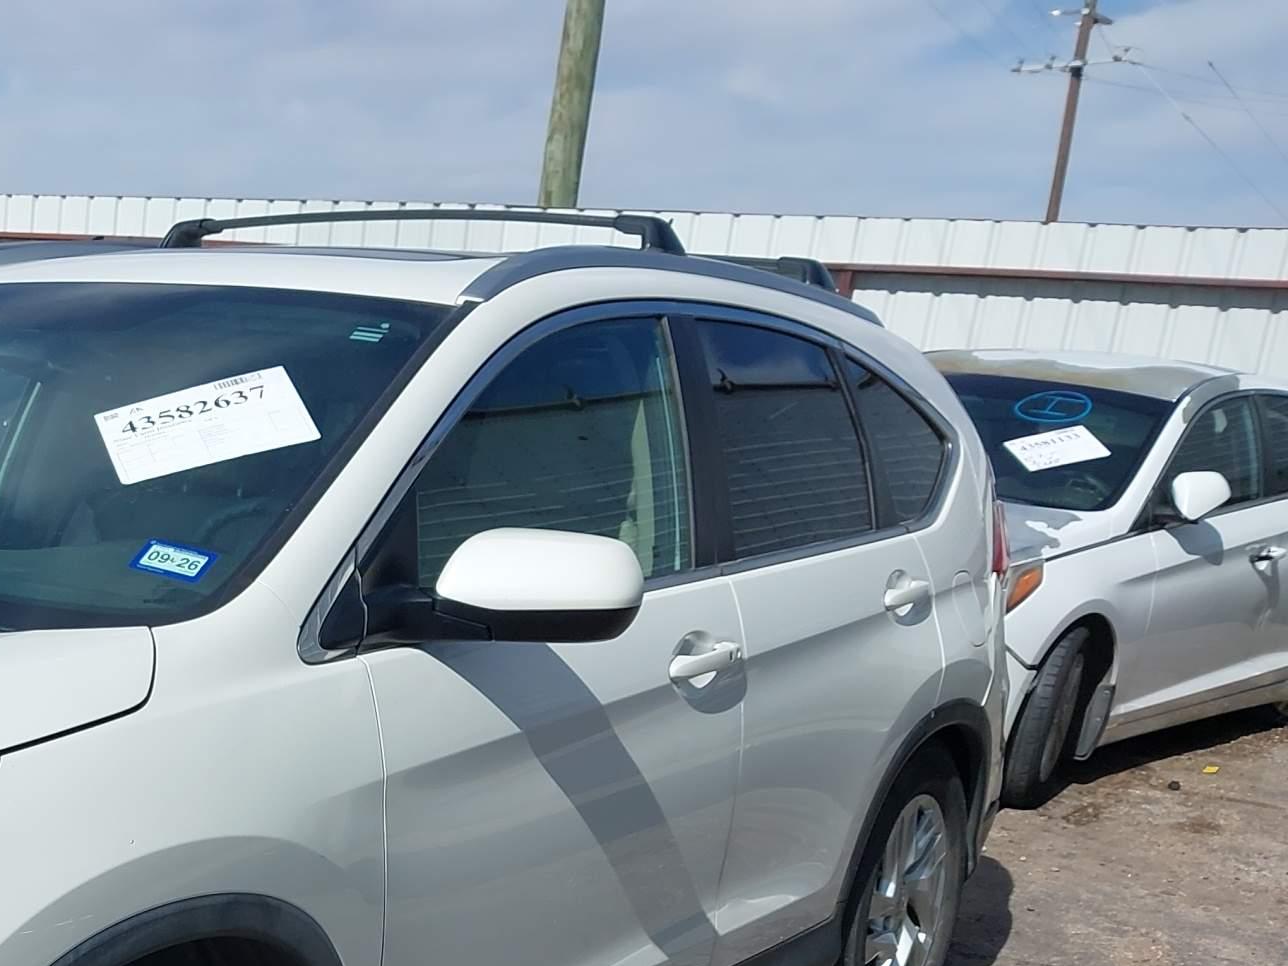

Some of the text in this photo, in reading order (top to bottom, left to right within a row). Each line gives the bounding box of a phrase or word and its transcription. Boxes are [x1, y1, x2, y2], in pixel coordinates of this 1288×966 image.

[121, 384, 265, 434] 43582637
[147, 550, 171, 564] 09
[176, 557, 201, 571] 26
